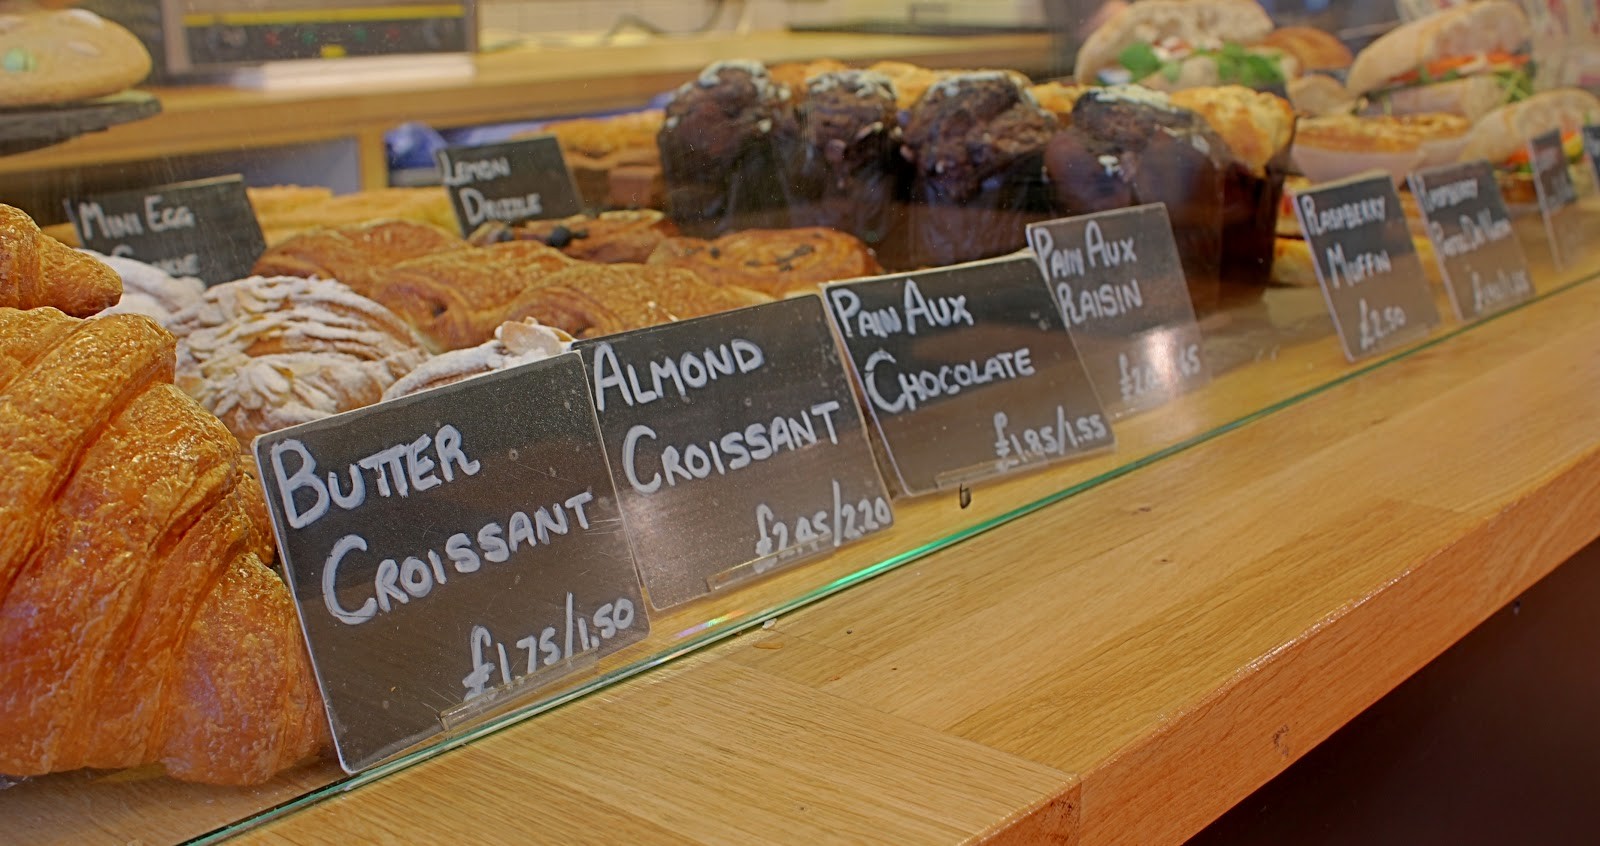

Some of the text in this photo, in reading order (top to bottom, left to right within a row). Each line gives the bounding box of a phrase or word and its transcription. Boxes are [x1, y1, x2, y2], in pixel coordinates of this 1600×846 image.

[438, 151, 512, 187] LEMON
[79, 194, 196, 240] MINI EGG
[459, 187, 543, 226] DRIZZLE
[1301, 194, 1385, 236] RASPBERRY
[1034, 219, 1138, 279] PAIN AUX
[1326, 242, 1392, 289] MUFFIN
[831, 278, 974, 338] PAIN AUX
[1057, 279, 1143, 328] RAISIN
[1359, 297, 1406, 350] £2.50
[593, 339, 764, 412] ALMOND
[864, 347, 1036, 414] CHOCOLATE
[622, 400, 840, 496] CROISSANT
[994, 405, 1108, 472] £1.85/1.55
[271, 424, 480, 530] BUTTER
[754, 479, 892, 575] £2.45/2.20
[321, 490, 594, 626] CROISSANT
